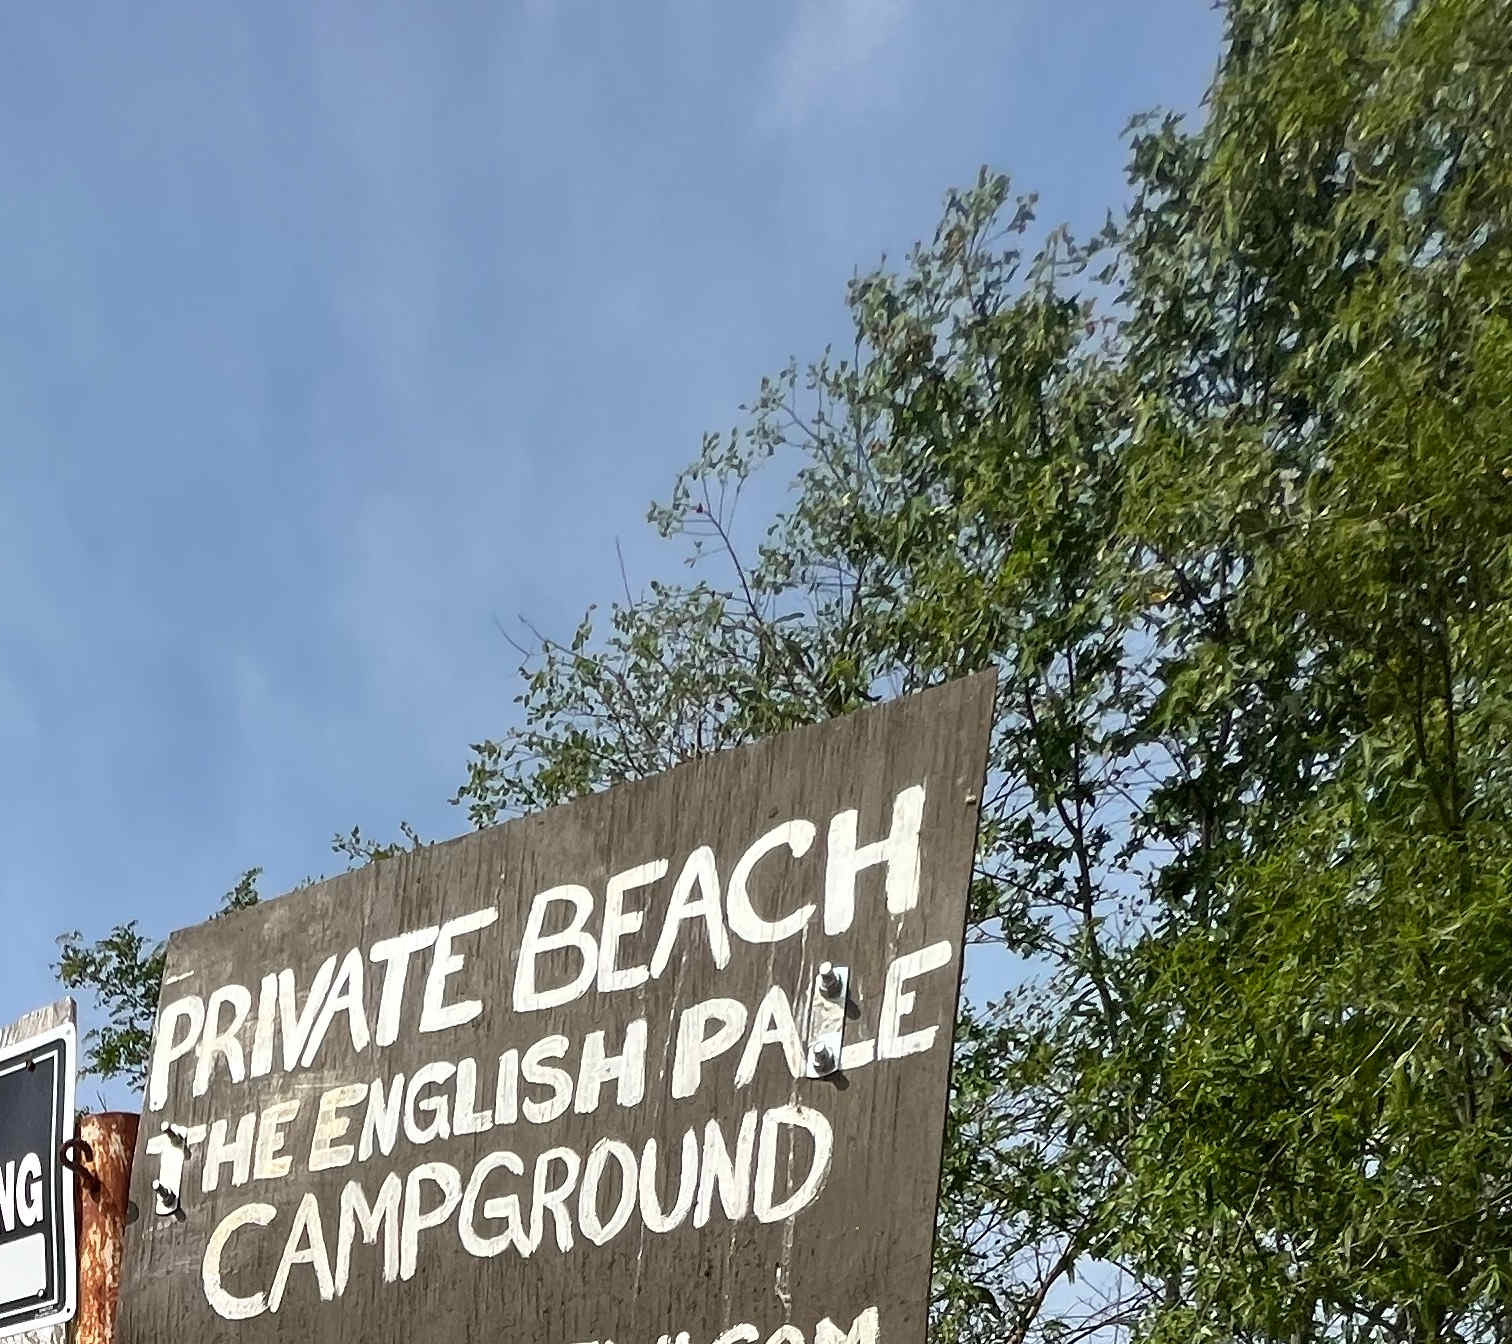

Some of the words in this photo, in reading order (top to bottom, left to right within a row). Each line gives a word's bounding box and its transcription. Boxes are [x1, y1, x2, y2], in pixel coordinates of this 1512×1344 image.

[148, 906, 499, 1113] PRIVATE
[512, 783, 928, 1014] BEACH
[145, 1098, 302, 1208] THE
[308, 1017, 648, 1174] ENGLISH
[201, 1102, 835, 1322] CAMPGROUND
